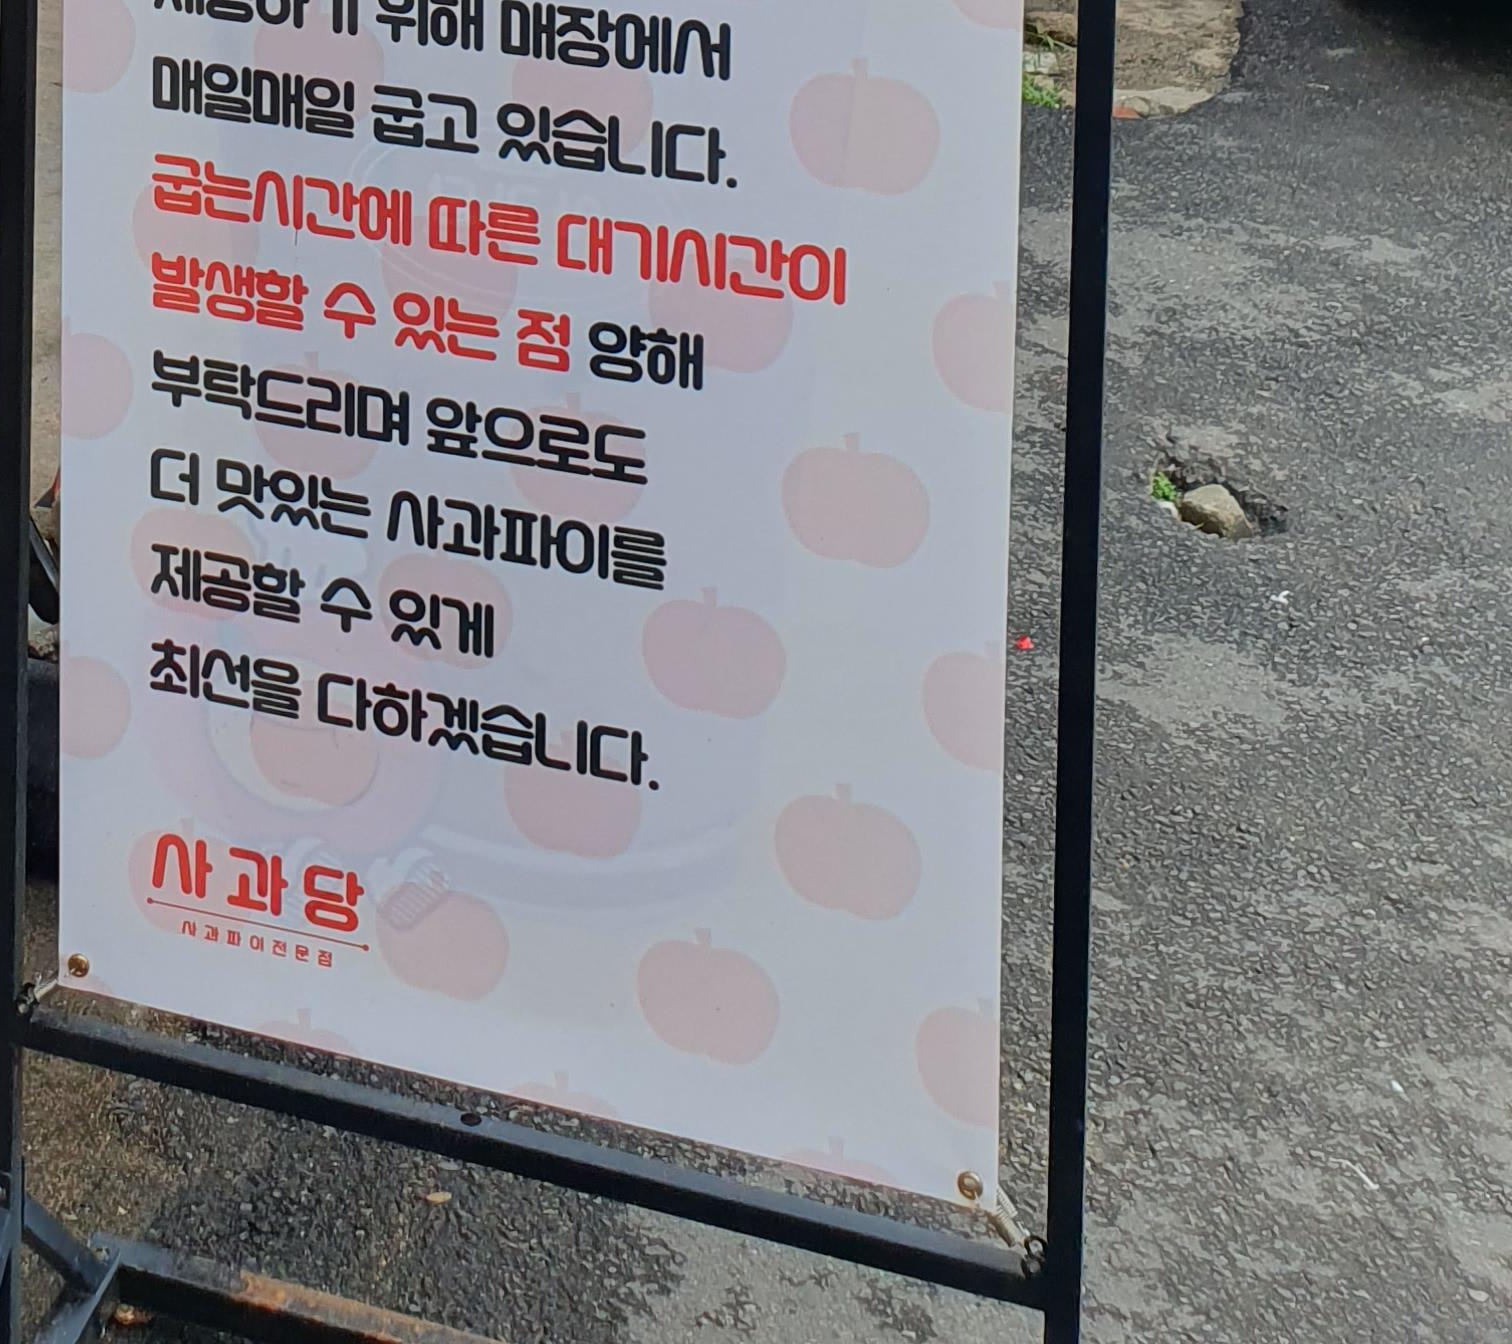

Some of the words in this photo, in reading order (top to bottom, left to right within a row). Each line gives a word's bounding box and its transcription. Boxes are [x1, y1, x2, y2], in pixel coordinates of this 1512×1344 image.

[500, 0, 731, 81] 매장에서
[152, 55, 355, 139] 매일매일
[370, 84, 480, 154] 굽고
[496, 102, 738, 189] 있습니다.
[152, 155, 411, 245] 굽는시간에
[429, 198, 539, 265] 따른
[557, 215, 845, 305] 대기시간이
[151, 254, 306, 330] 발생할
[324, 284, 374, 338] 수
[394, 293, 498, 360] 있는
[517, 311, 569, 371] 점
[588, 321, 704, 391] 양해
[151, 349, 410, 446] 부탁드리며
[425, 397, 648, 485] 앞으로도
[150, 448, 200, 506] 더
[216, 459, 372, 539] 맛있는
[386, 490, 667, 591] 사과파이를
[150, 543, 306, 624] 제공할
[319, 577, 373, 633] 수
[388, 592, 495, 659] 있게
[149, 638, 302, 720] 최선을
[317, 672, 659, 791] 다하겠습니다.
[152, 835, 362, 932] 사과당
[179, 920, 335, 968] 사과파이전문점
